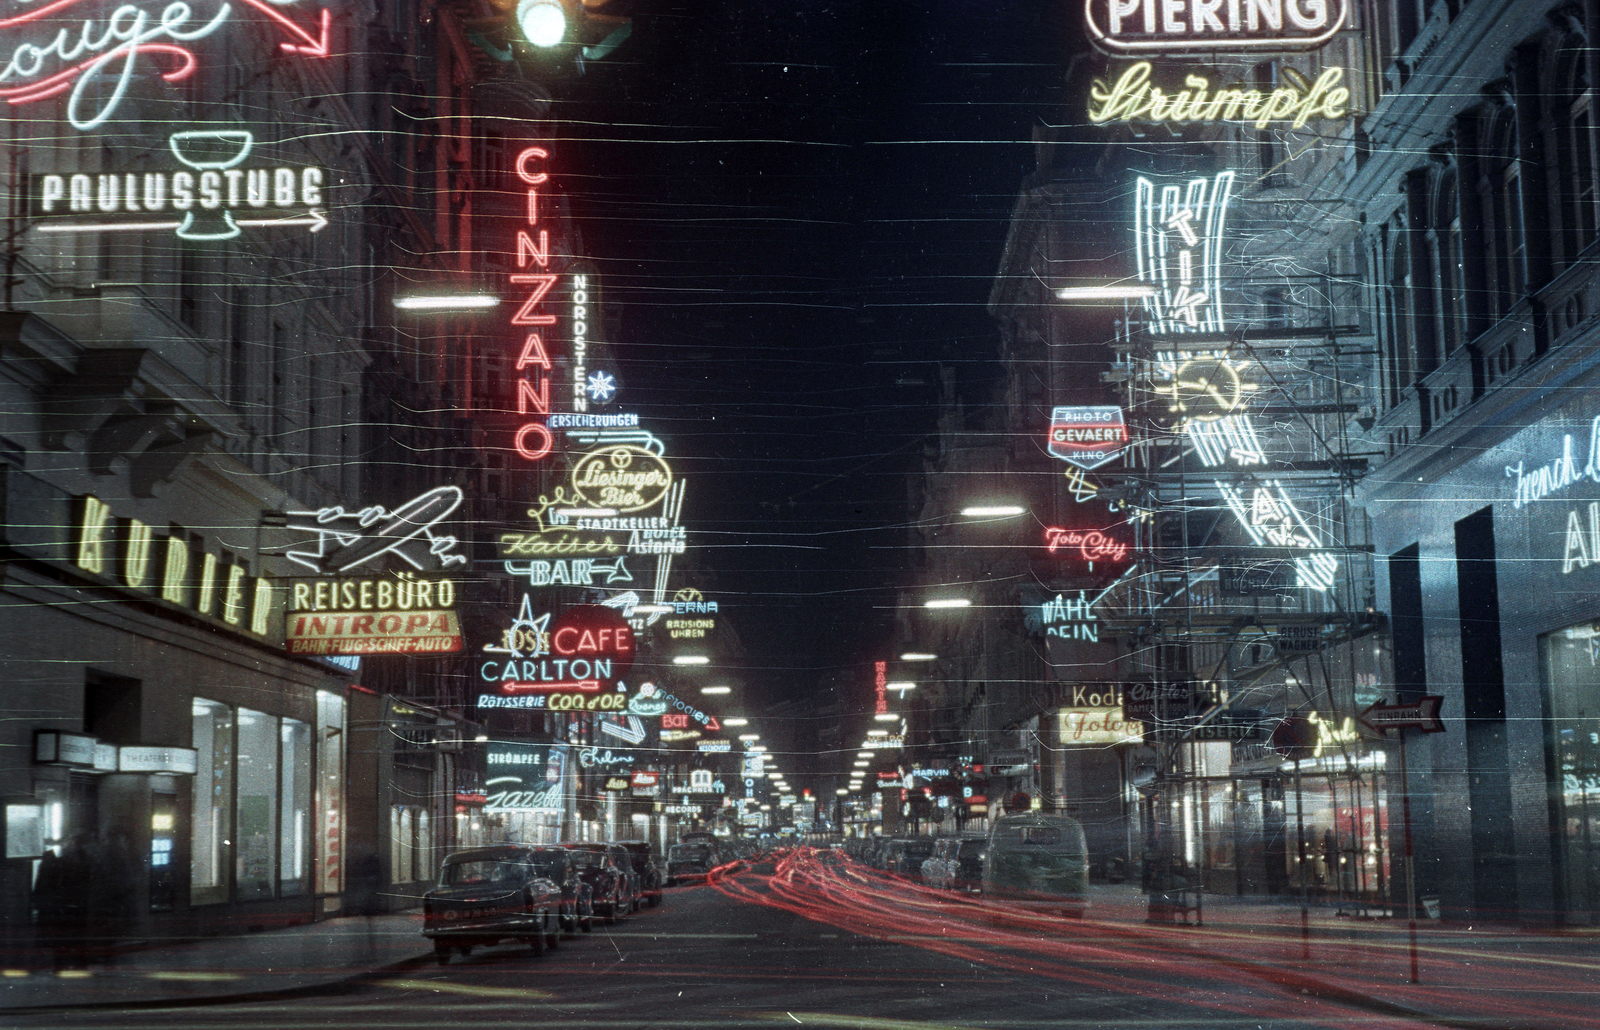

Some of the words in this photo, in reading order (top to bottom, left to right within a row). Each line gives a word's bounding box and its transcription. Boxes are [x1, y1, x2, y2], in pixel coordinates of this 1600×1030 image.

[1107, 0, 1328, 34] PIERING
[0, 2, 232, 131] ouge
[1088, 61, 1350, 130] Strümpfe
[42, 167, 324, 212] PAULUSSTUBE
[510, 147, 557, 460] CINZANO
[573, 275, 587, 412] NORDSTERN
[1064, 411, 1112, 422] PHOTO
[1053, 427, 1123, 442] GEVAERT
[1072, 450, 1106, 460] KINO
[577, 460, 667, 490] Liesinger
[600, 486, 645, 506] Bier
[576, 516, 669, 530] STADTKELLER
[642, 526, 687, 540] HOTEL
[500, 533, 620, 554] Kaiser
[627, 530, 686, 554] Astoria
[1081, 532, 1127, 561] City
[77, 495, 272, 636] KURIER
[530, 559, 593, 586] BAR
[293, 572, 454, 610] REISEBÜRO
[293, 614, 450, 636] INTROPA
[670, 629, 706, 638] UHREN
[554, 626, 630, 654] CAFE
[480, 658, 612, 682] CARLTON
[547, 693, 585, 710] COQ
[1377, 710, 1422, 723] EINBAHN
[487, 752, 541, 764] STRÜMPFE
[912, 769, 949, 777] MARVIN
[665, 805, 702, 814] RECORDS
